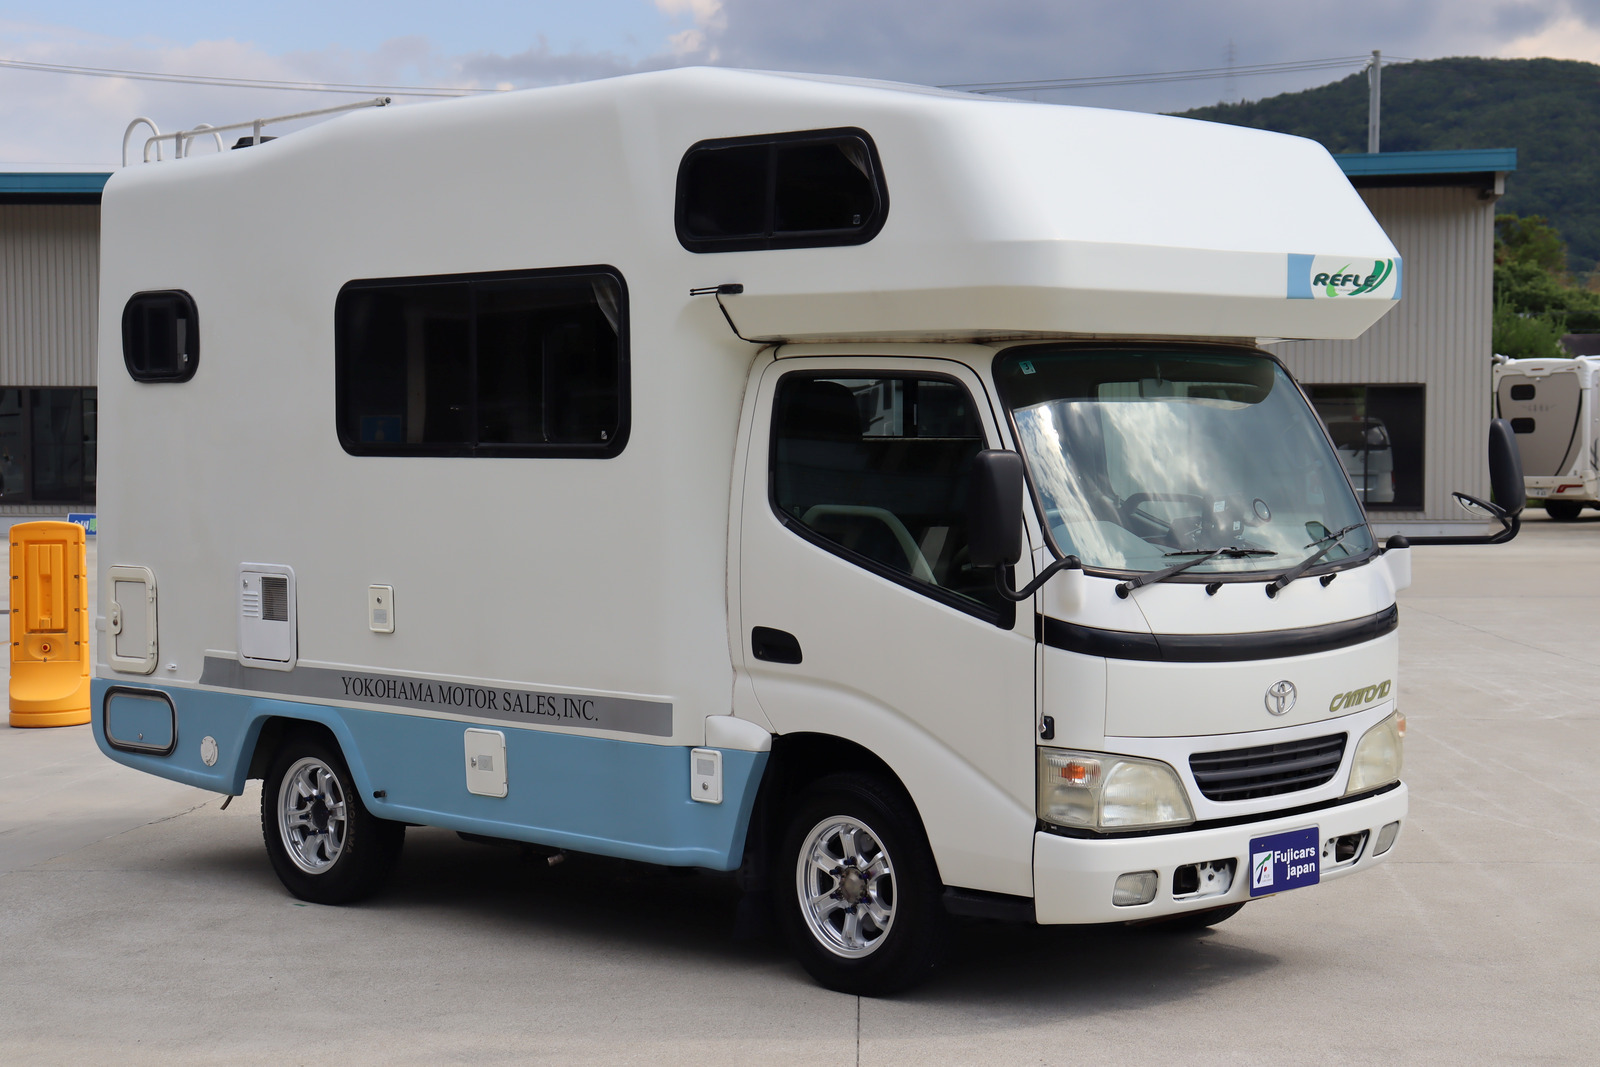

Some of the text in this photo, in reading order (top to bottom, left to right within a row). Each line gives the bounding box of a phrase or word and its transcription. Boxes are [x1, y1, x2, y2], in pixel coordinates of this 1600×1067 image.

[1313, 272, 1376, 287] REFLE
[342, 677, 434, 703] YOKOHAMA
[438, 685, 498, 711] MOTOR
[1274, 847, 1316, 864] Fujicars
[1286, 862, 1316, 880] japan
